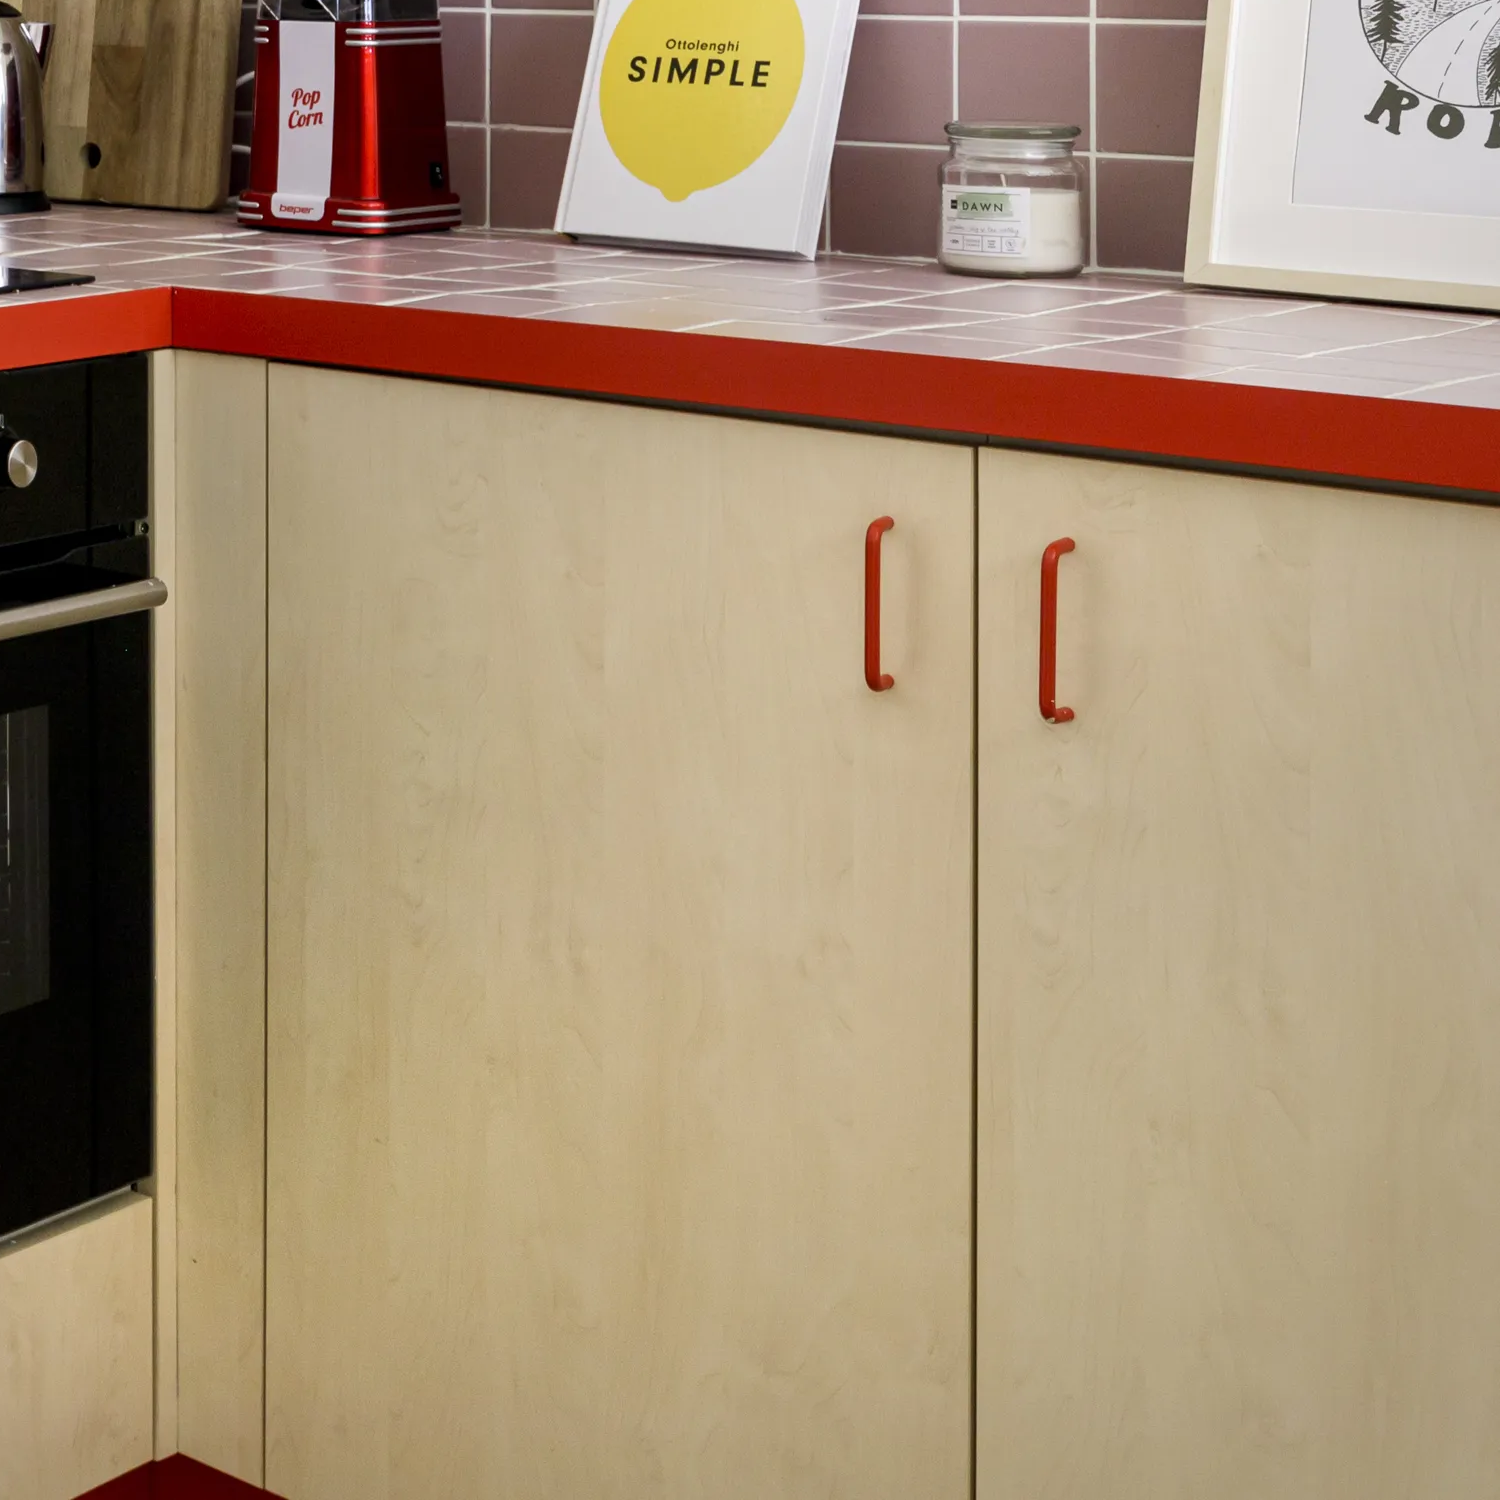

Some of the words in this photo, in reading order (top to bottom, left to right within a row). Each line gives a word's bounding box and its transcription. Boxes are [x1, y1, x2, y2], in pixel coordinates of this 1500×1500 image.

[665, 38, 740, 54] Ottolenghi
[627, 55, 771, 88] SIMPLE
[291, 88, 321, 110] Pop
[287, 108, 324, 129] Corn
[279, 204, 314, 215] beper
[962, 201, 1003, 212] DAWN
